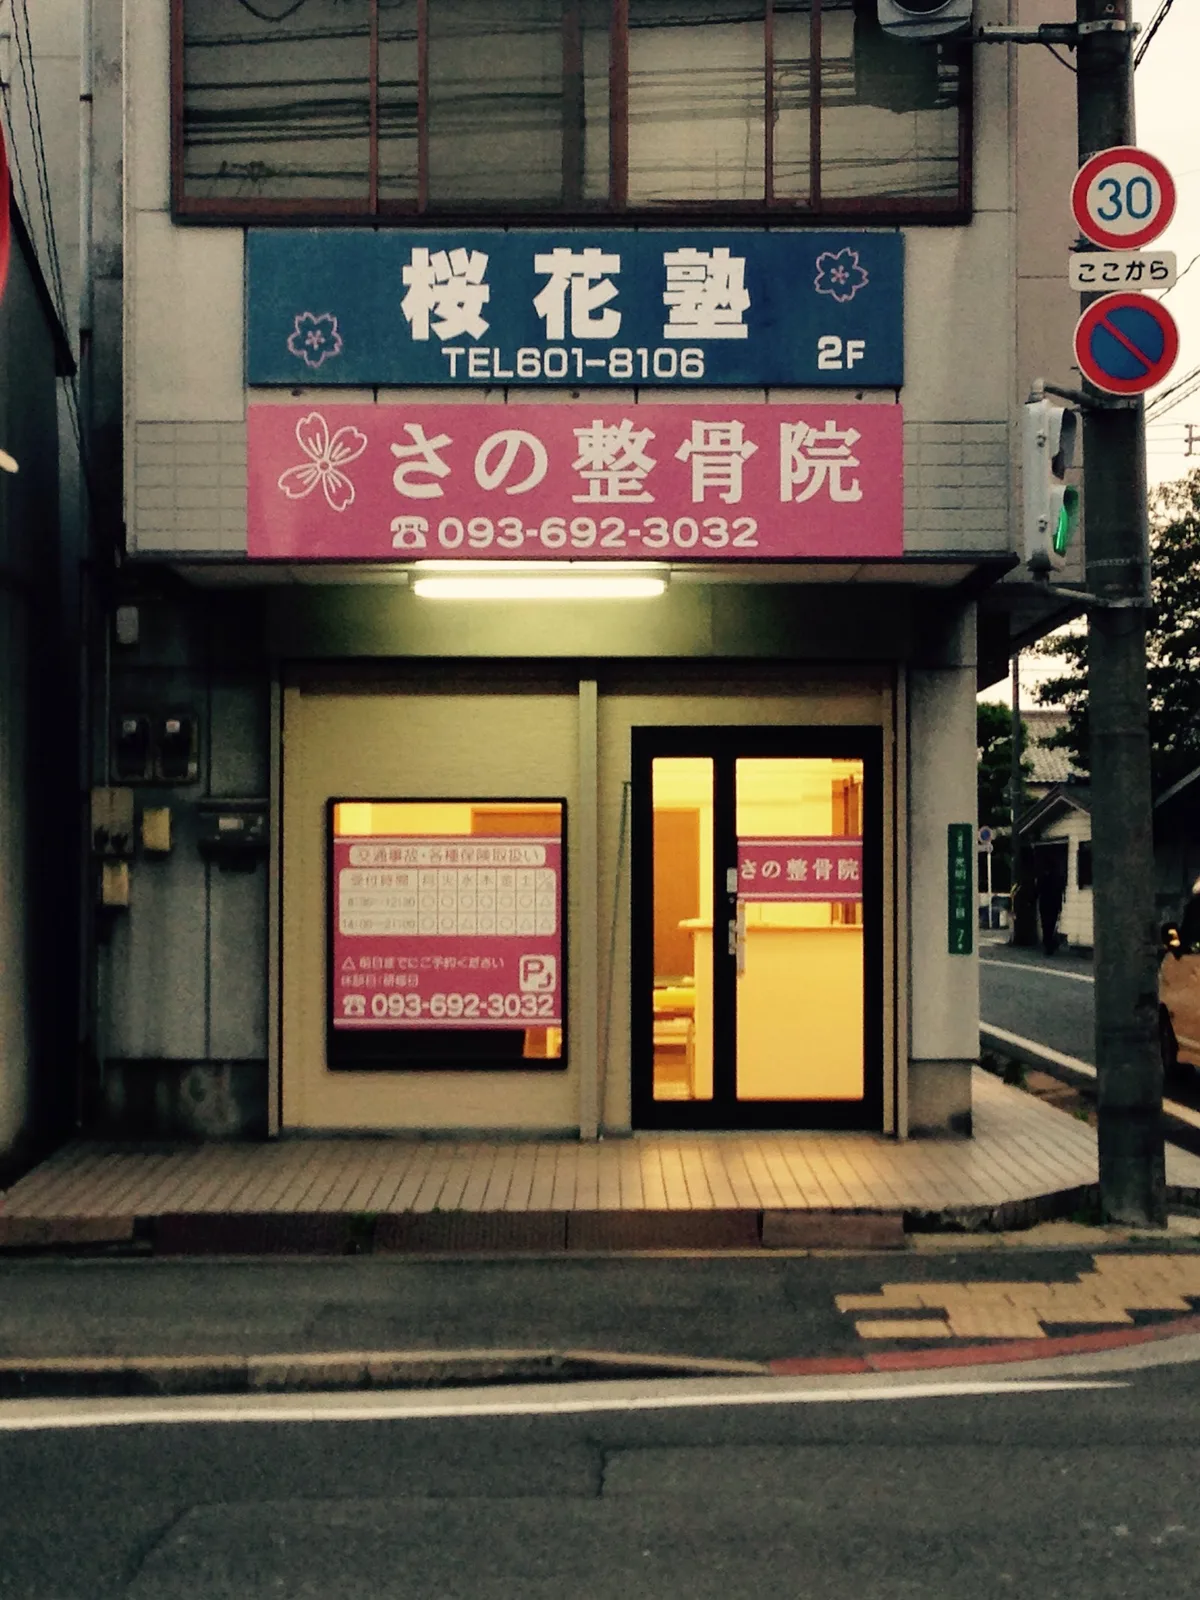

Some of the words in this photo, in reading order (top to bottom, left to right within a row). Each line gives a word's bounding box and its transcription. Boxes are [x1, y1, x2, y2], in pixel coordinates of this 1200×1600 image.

[1097, 176, 1153, 221] 30
[1077, 260, 1170, 283] ここから
[401, 247, 751, 341] 桜花塾
[817, 336, 866, 370] 2F
[390, 418, 863, 505] さの整骨院
[437, 517, 759, 550] 093-692-3032
[741, 858, 860, 882] さの整骨院
[371, 993, 554, 1018] 093-692-3032
